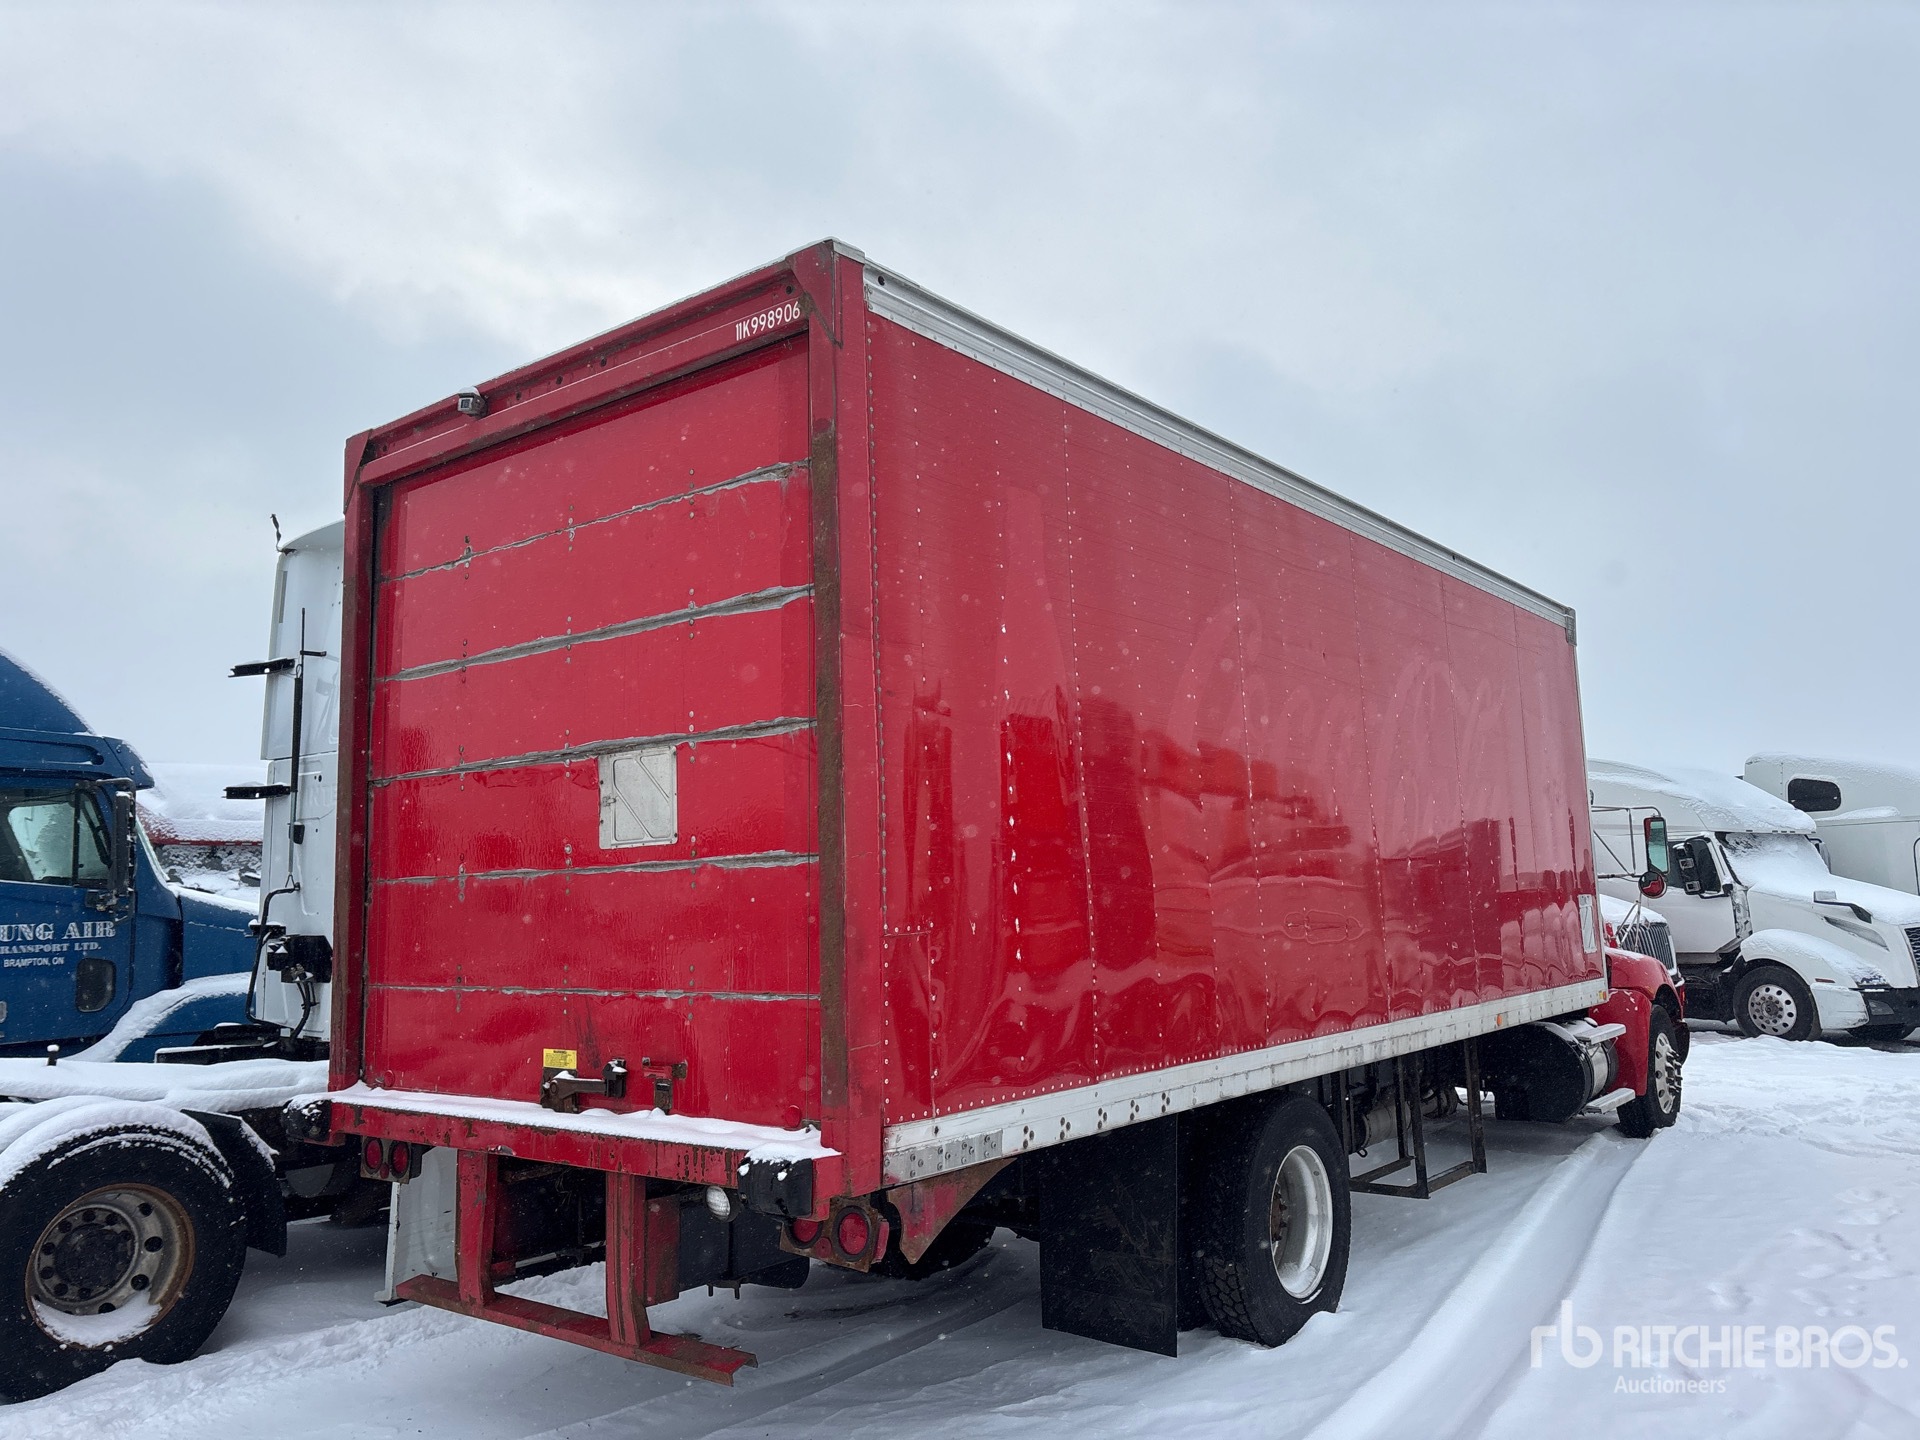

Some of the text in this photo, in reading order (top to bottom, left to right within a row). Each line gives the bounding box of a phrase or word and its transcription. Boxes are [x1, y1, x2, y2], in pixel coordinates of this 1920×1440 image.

[62, 921, 116, 939] AIR
[74, 942, 101, 951] LTD.
[52, 956, 65, 965] ON
